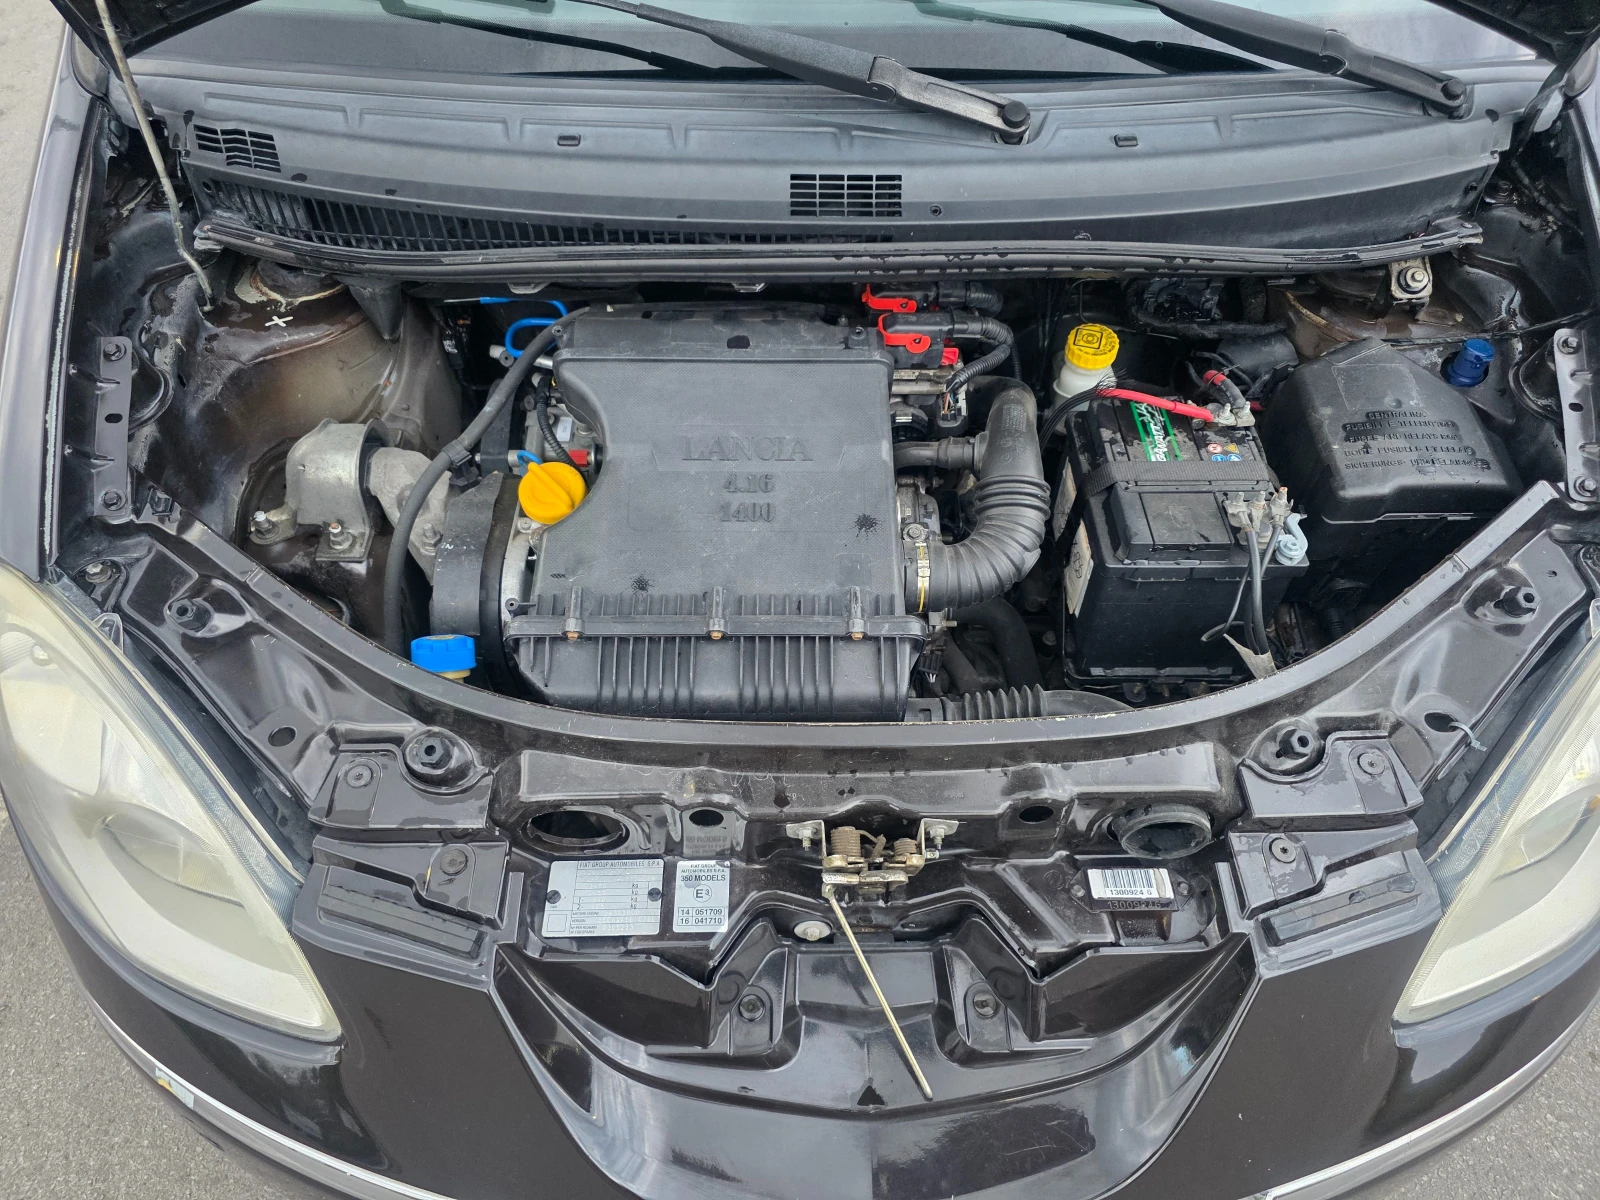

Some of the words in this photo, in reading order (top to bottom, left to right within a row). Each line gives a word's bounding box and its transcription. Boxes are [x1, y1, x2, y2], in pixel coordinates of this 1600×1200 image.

[682, 436, 813, 461] LANCIA
[723, 473, 775, 493] 4.16
[719, 502, 776, 522] 1400
[609, 860, 645, 868] AUTOMOBILES
[694, 874, 726, 882] MODELS
[680, 908, 690, 916] 14
[695, 908, 723, 916] 051709
[694, 917, 722, 925] 041710
